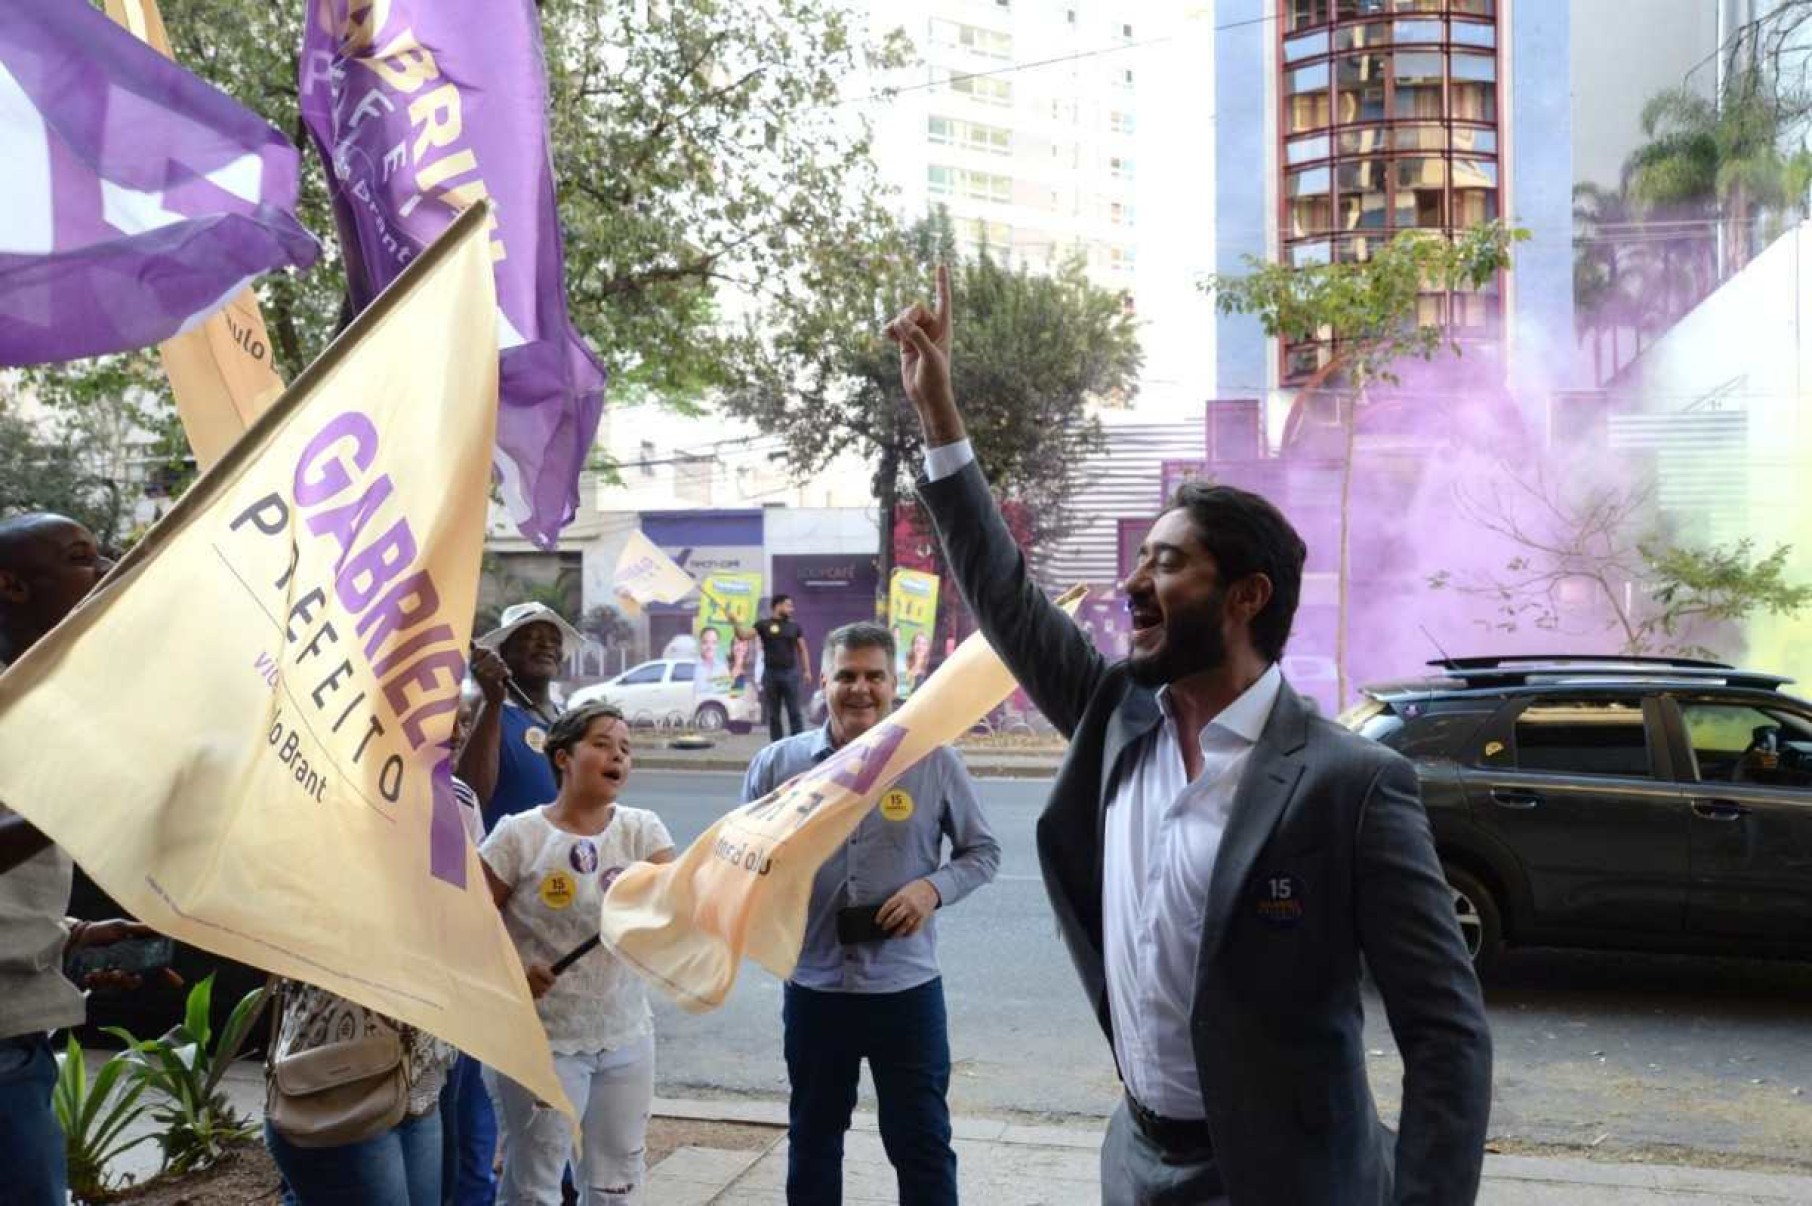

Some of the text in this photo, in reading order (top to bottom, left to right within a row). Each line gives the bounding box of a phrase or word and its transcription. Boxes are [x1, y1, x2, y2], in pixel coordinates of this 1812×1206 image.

[292, 410, 466, 752] GABRIEL
[278, 730, 327, 804] Brant
[551, 876, 567, 890] 15
[1268, 878, 1292, 900] 15
